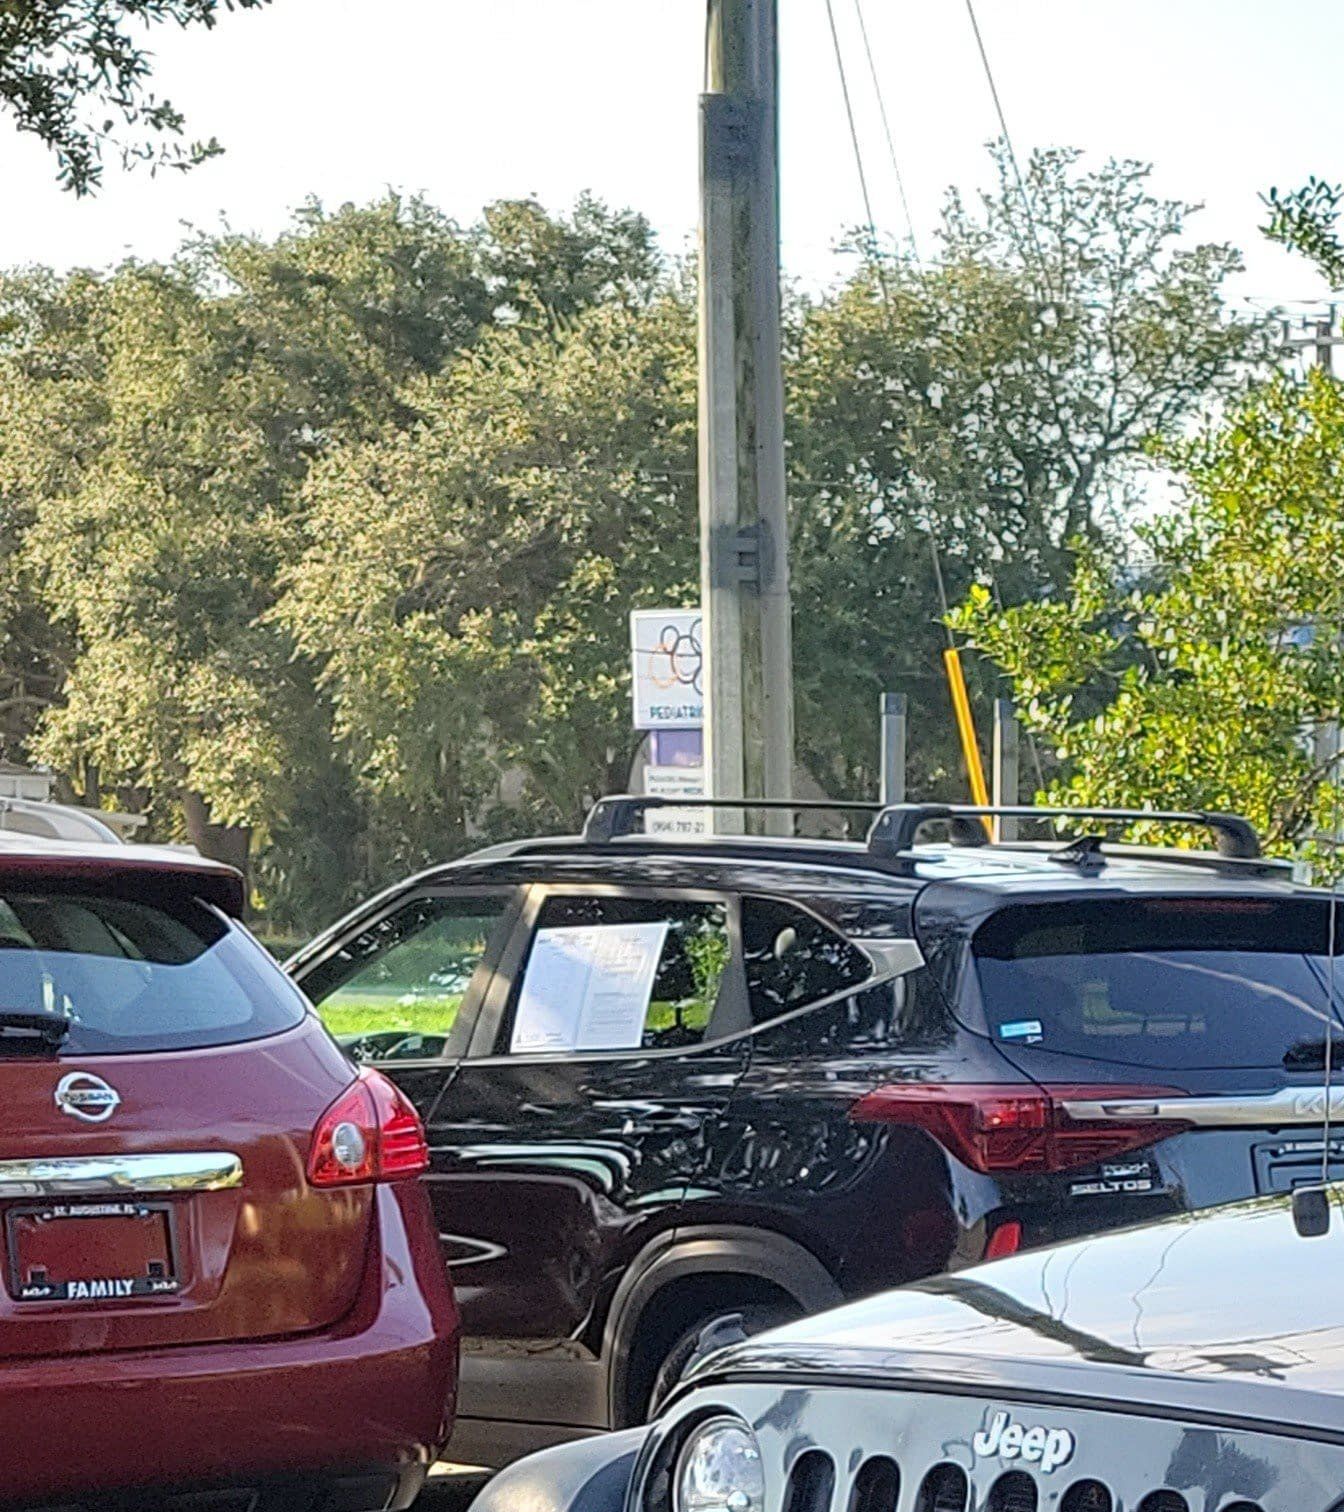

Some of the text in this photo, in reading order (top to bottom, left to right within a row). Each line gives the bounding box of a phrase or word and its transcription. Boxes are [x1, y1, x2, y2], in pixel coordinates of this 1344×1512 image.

[1071, 1180, 1152, 1196] SELTOS
[67, 1279, 135, 1299] FAMILY
[973, 1411, 1075, 1475] Jeep
